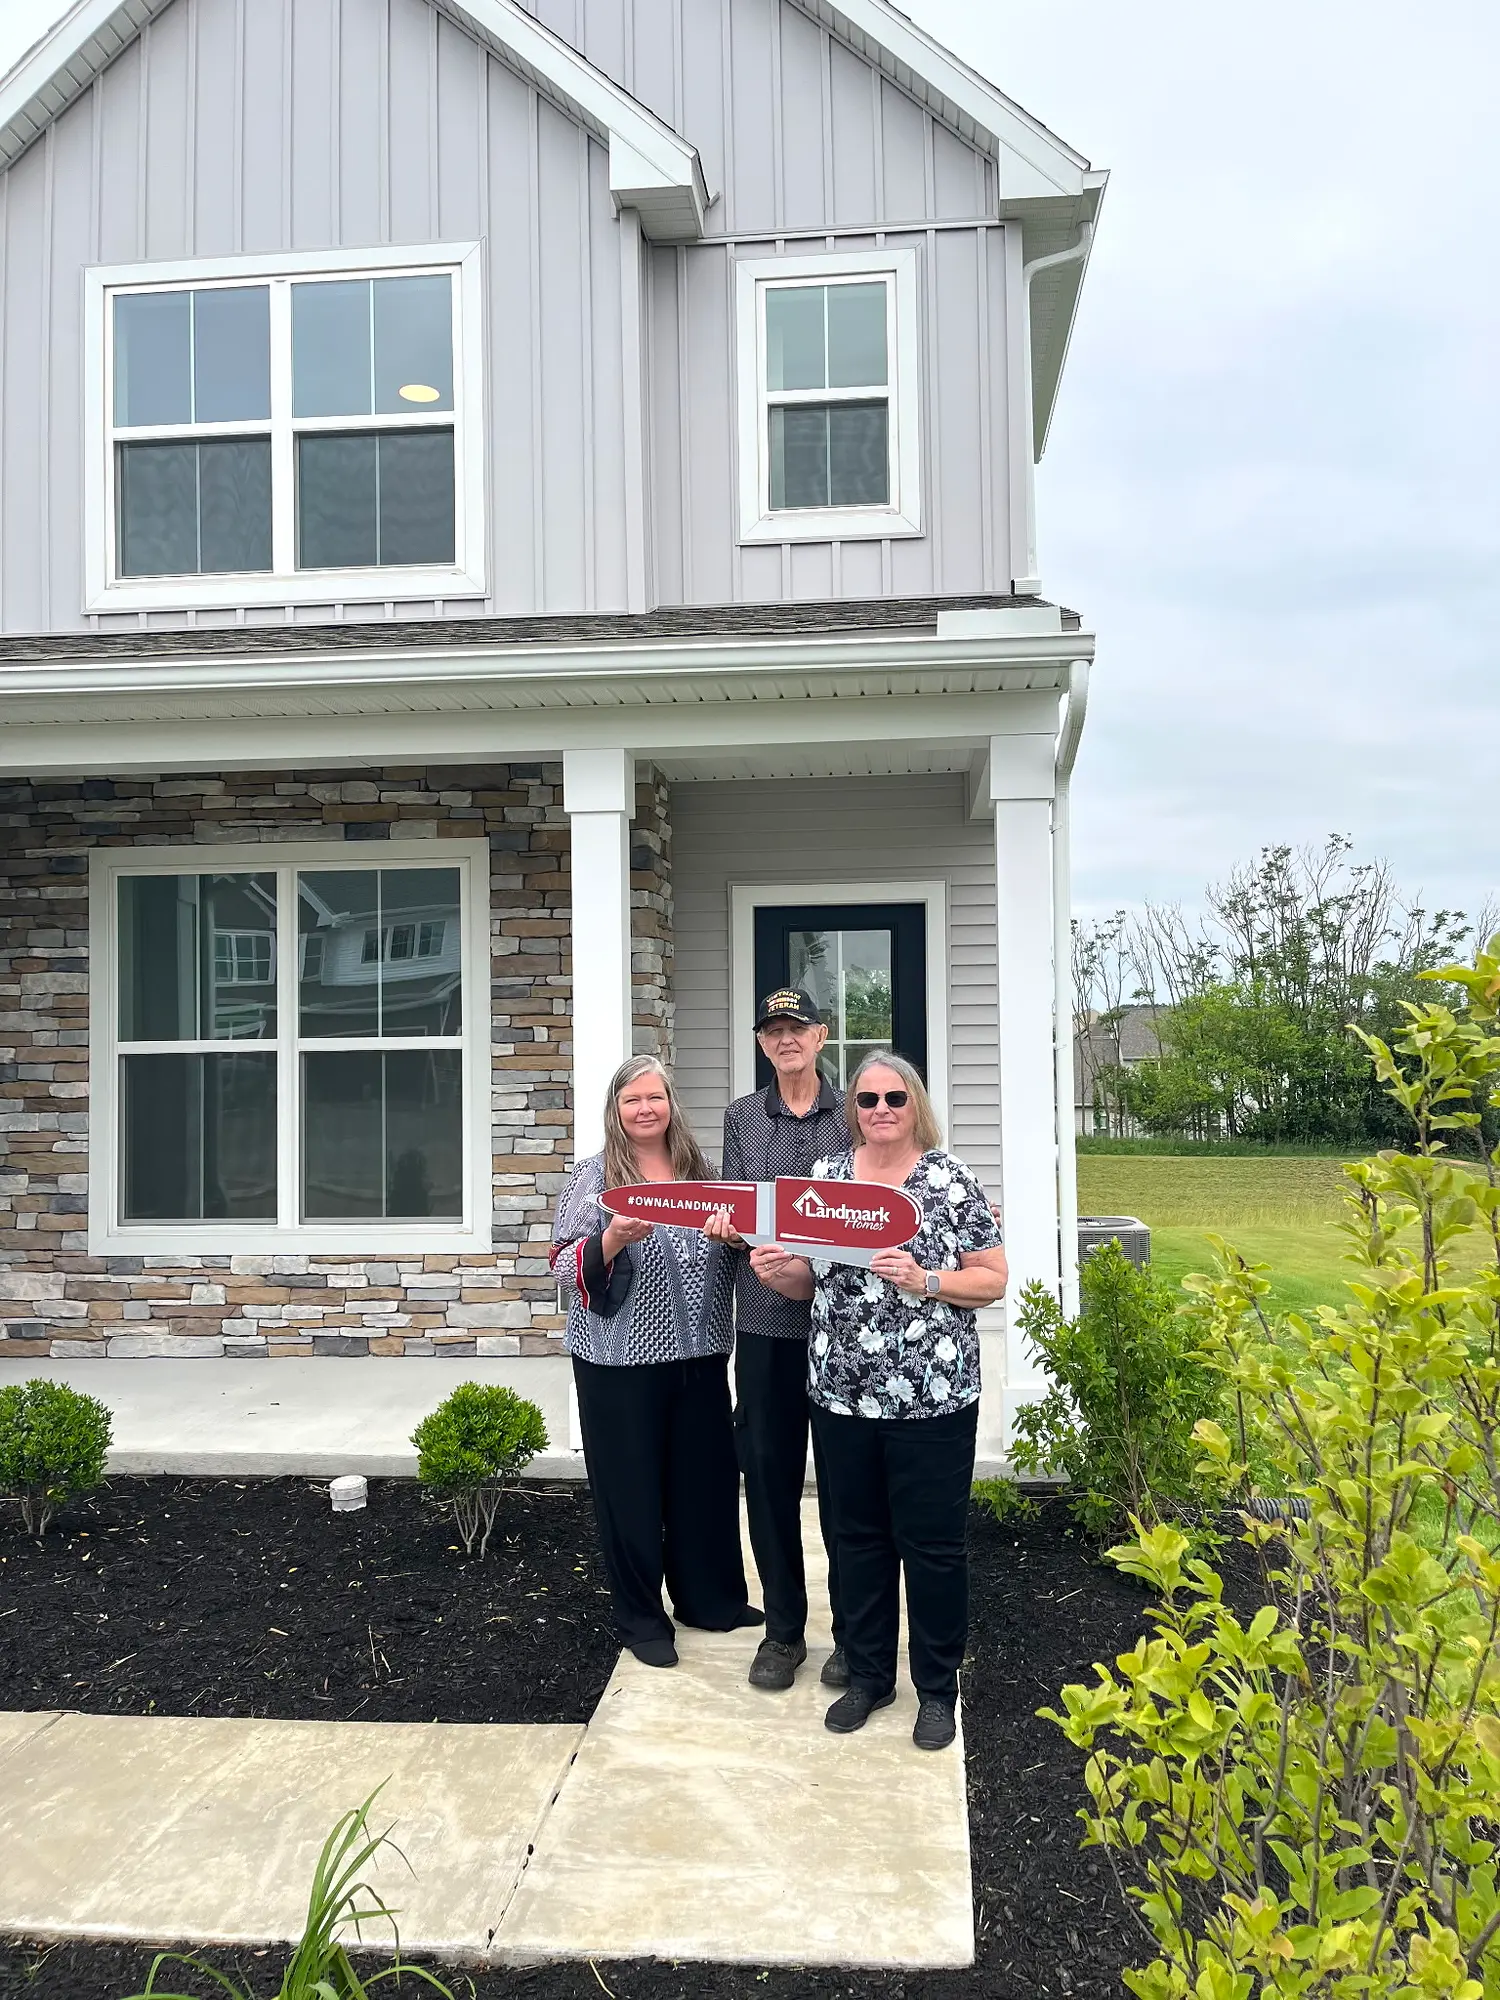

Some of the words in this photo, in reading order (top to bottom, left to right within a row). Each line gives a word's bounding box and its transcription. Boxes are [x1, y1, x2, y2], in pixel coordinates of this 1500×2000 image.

[627, 1195, 735, 1213] #OWNALANDMARK
[805, 1201, 891, 1223] Landmark
[843, 1218, 885, 1231] Homes
